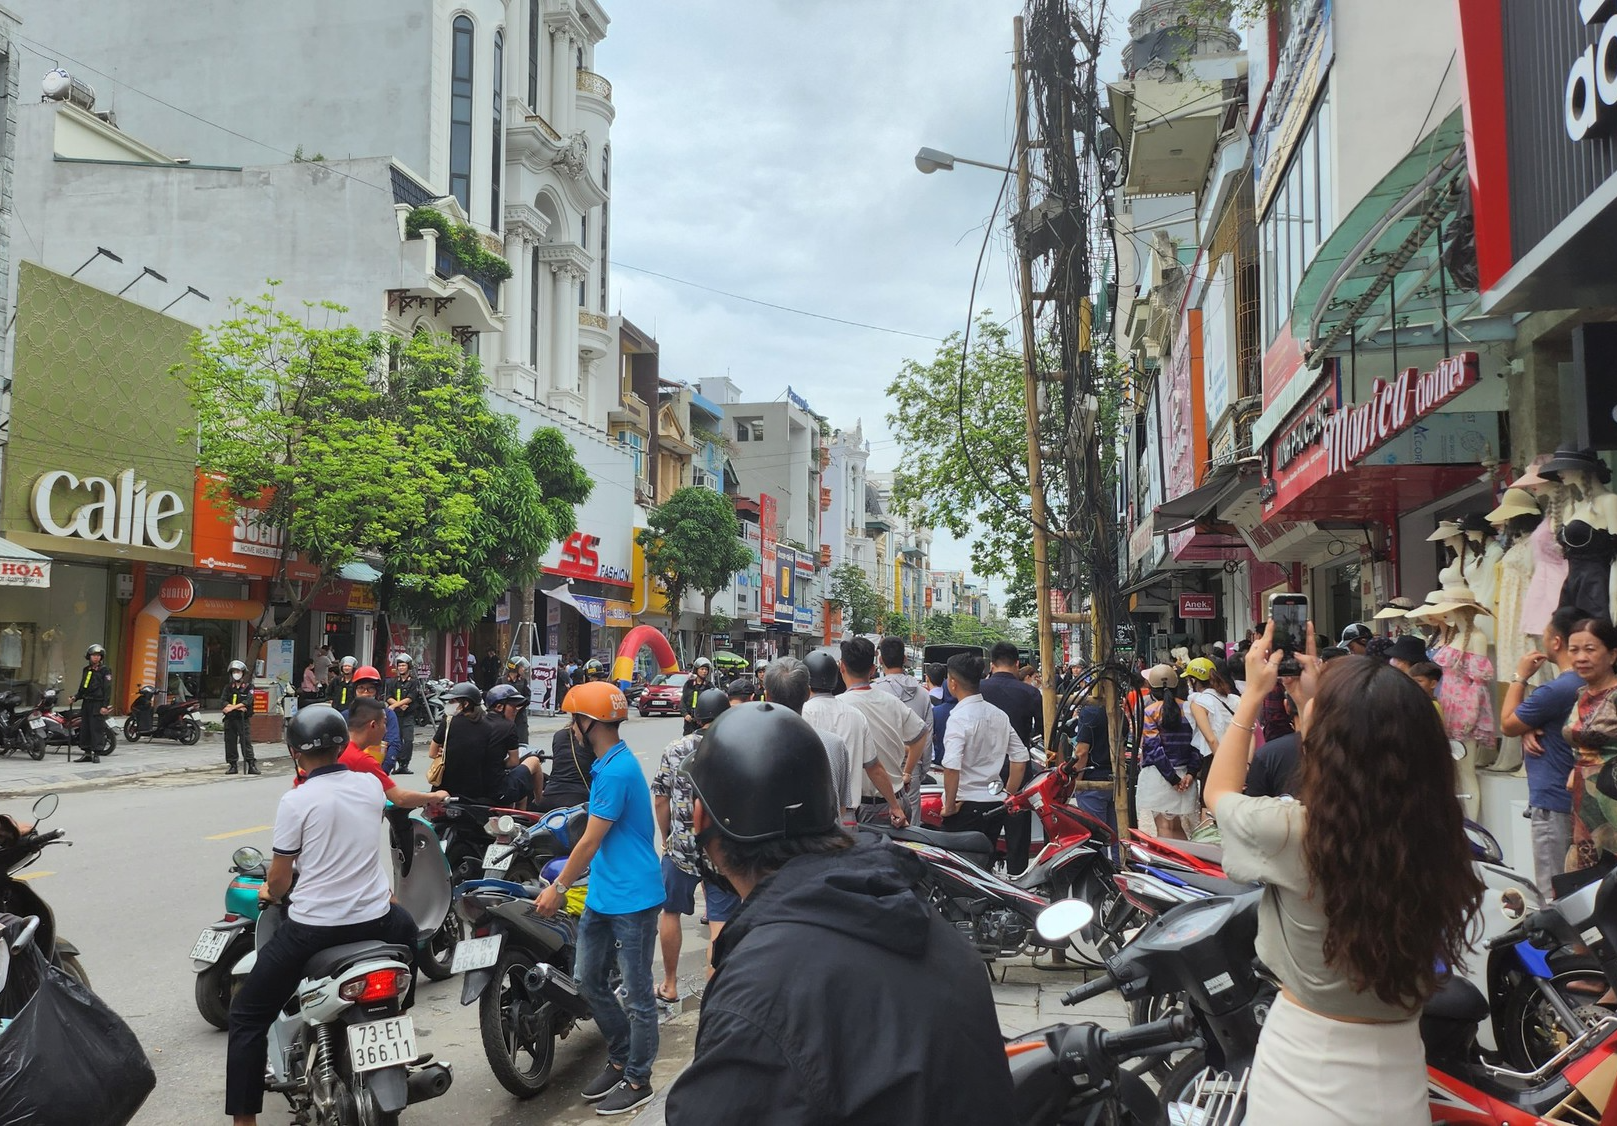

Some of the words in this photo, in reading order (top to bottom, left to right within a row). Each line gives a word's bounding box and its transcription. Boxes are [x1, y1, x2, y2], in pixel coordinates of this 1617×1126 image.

[1322, 369, 1409, 477] Monica
[240, 544, 255, 554] HOME
[600, 564, 630, 582] FASHION
[170, 645, 189, 661] 30%
[358, 1020, 402, 1045] 73-E1
[356, 1039, 411, 1067] 366.11
